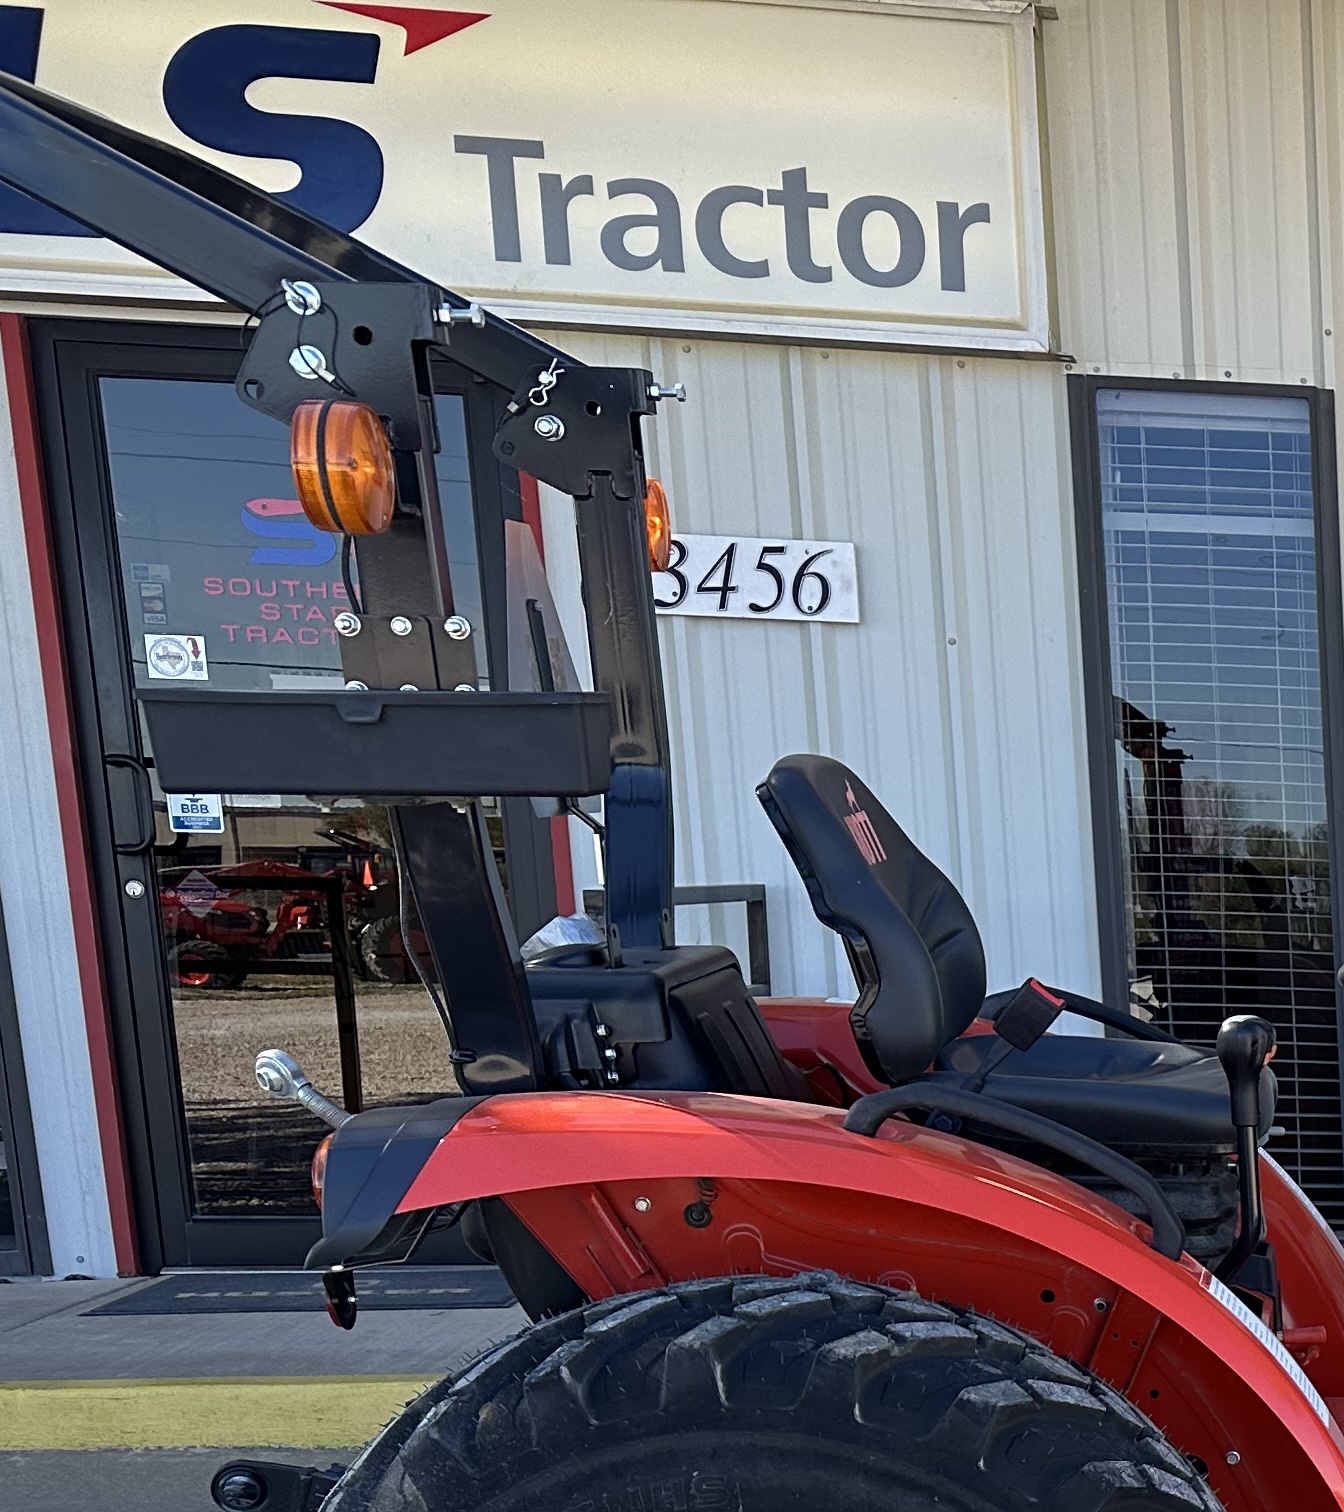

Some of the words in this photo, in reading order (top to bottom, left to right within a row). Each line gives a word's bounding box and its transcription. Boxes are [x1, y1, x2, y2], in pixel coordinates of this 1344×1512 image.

[453, 132, 991, 293] Tractor
[203, 576, 362, 602] SOUTHE
[221, 624, 339, 646] TRACT
[180, 803, 210, 814] BBB
